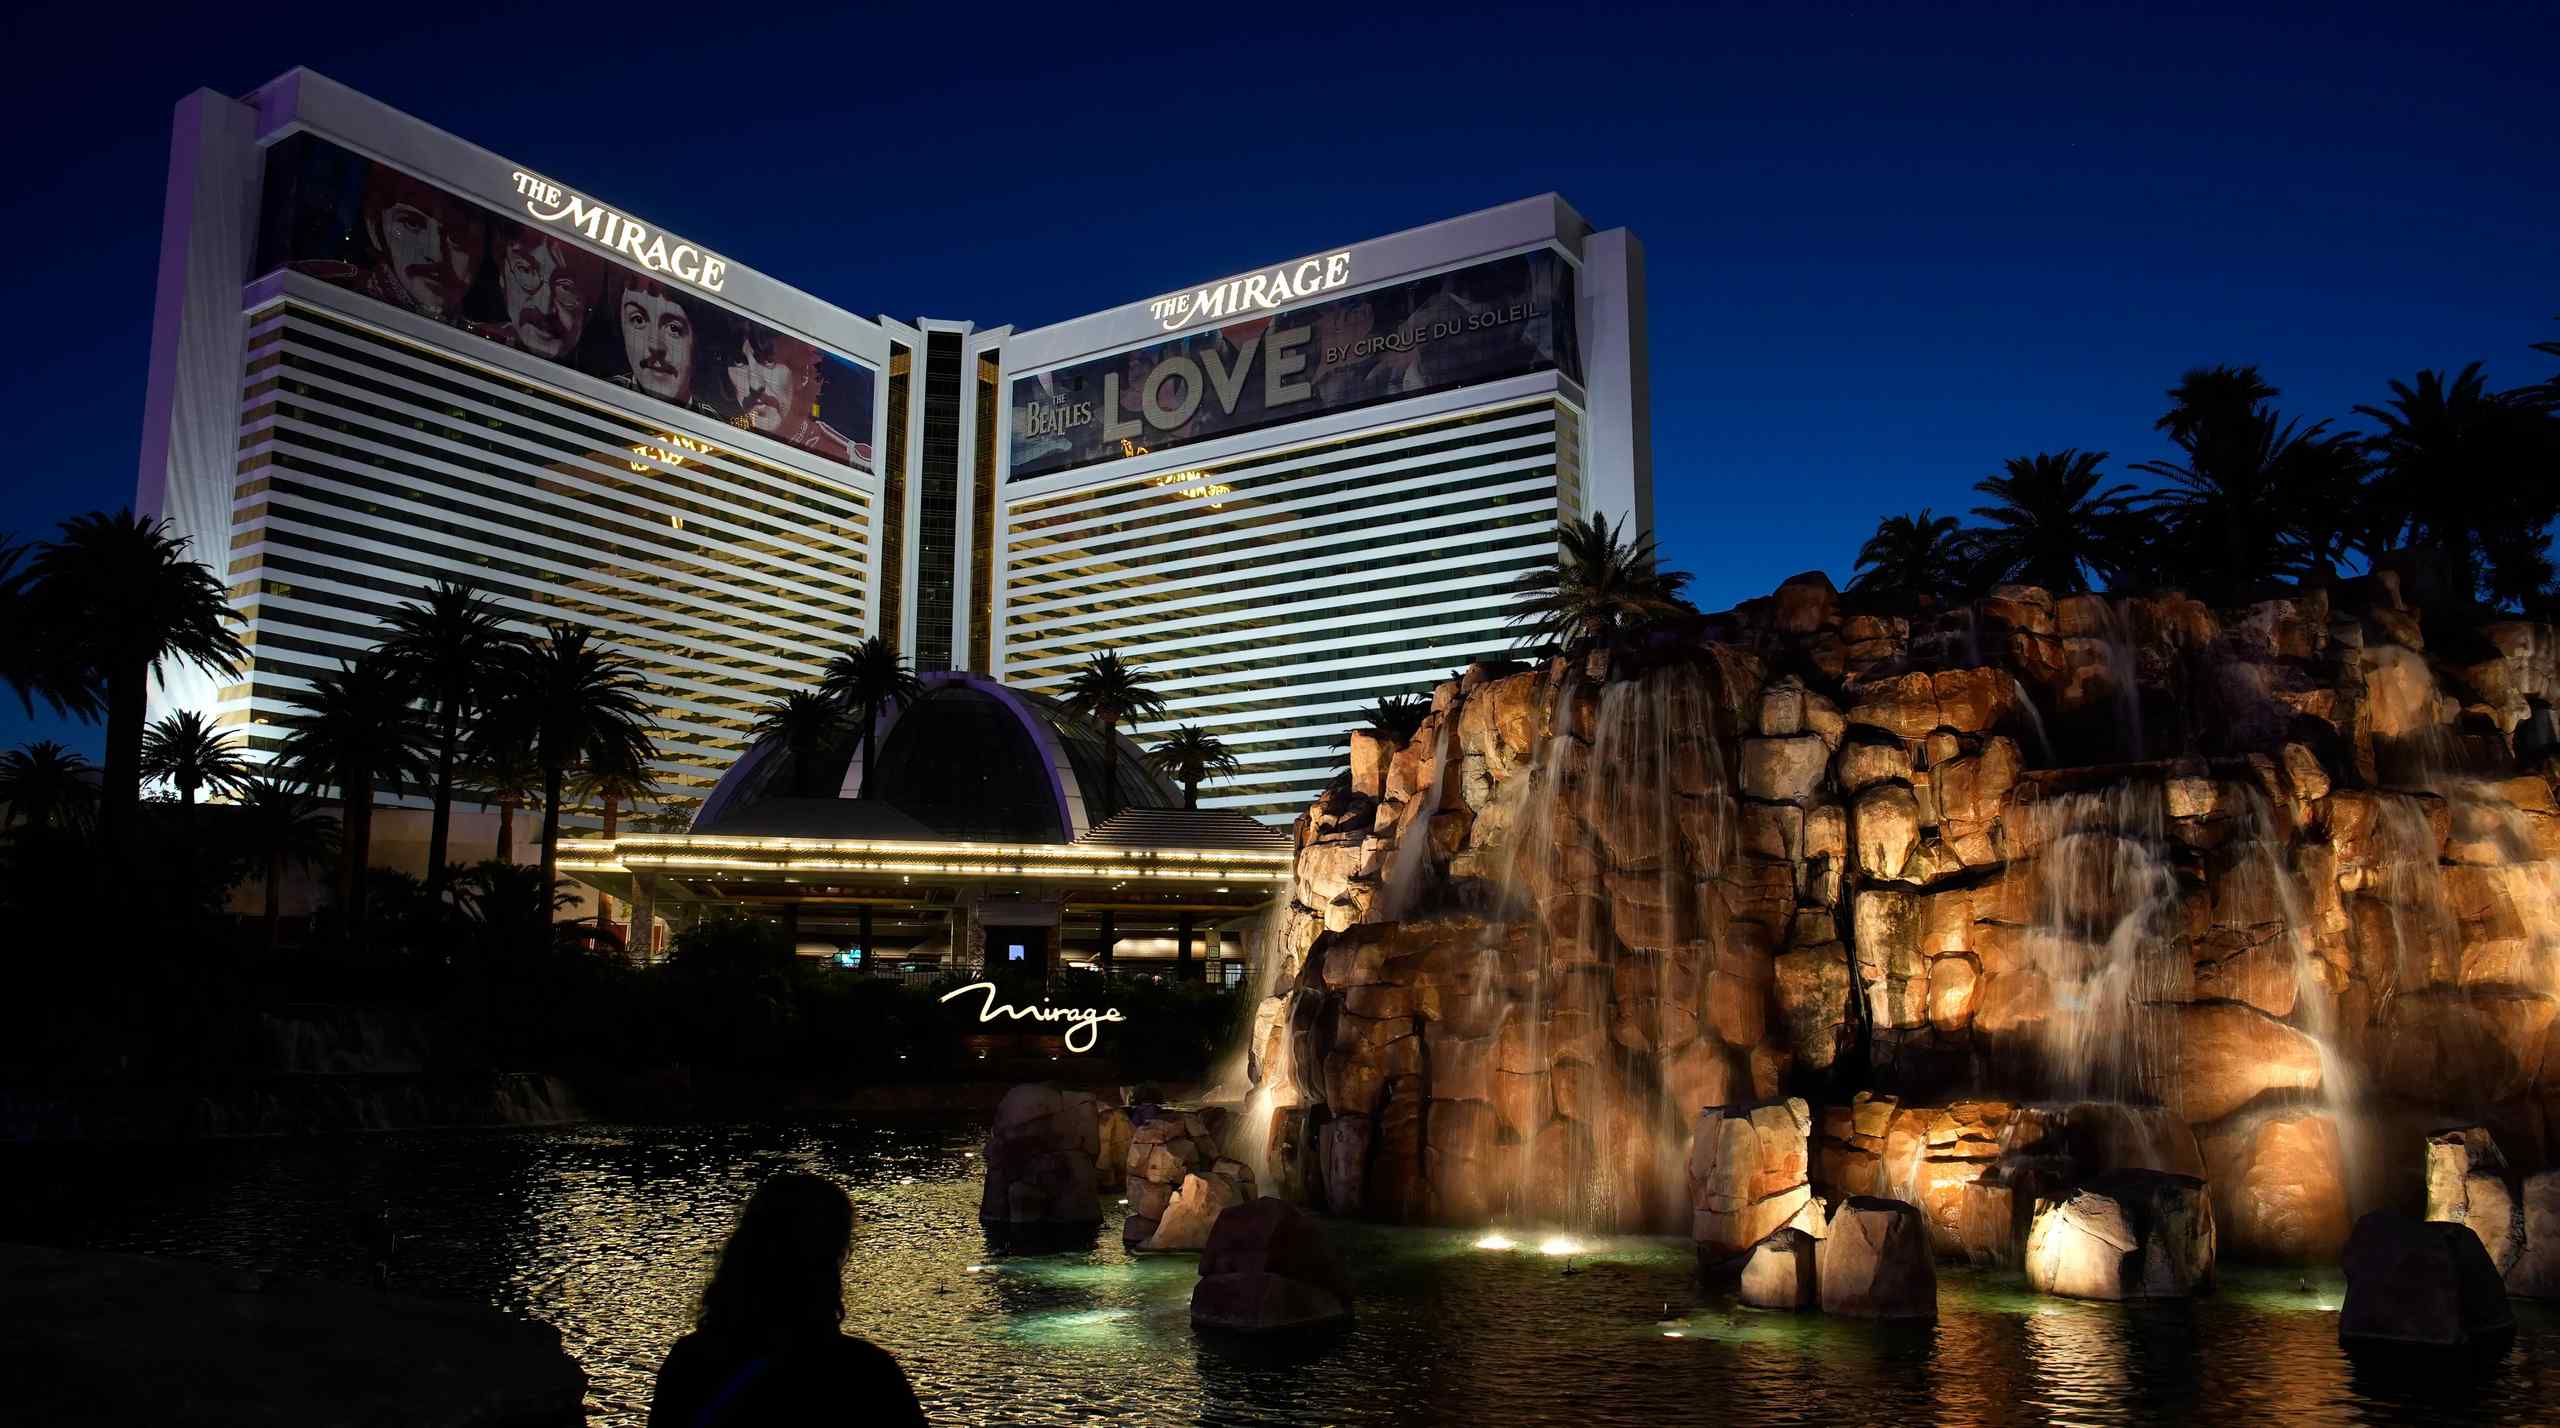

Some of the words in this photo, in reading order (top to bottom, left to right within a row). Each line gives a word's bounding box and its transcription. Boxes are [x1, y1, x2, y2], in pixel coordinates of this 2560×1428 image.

[513, 171, 561, 208] THE
[527, 195, 725, 292] MIRAGE
[1151, 294, 1190, 320] THE
[1163, 252, 1351, 331] MIRAGE
[1326, 344, 1350, 363] BY
[1354, 326, 1428, 353] CIRQUE
[1433, 318, 1462, 340] DU
[1467, 301, 1541, 330] SOLEIL
[1052, 393, 1067, 405] THE
[1103, 325, 1312, 442] LOVE
[1026, 400, 1092, 438] BEATLES
